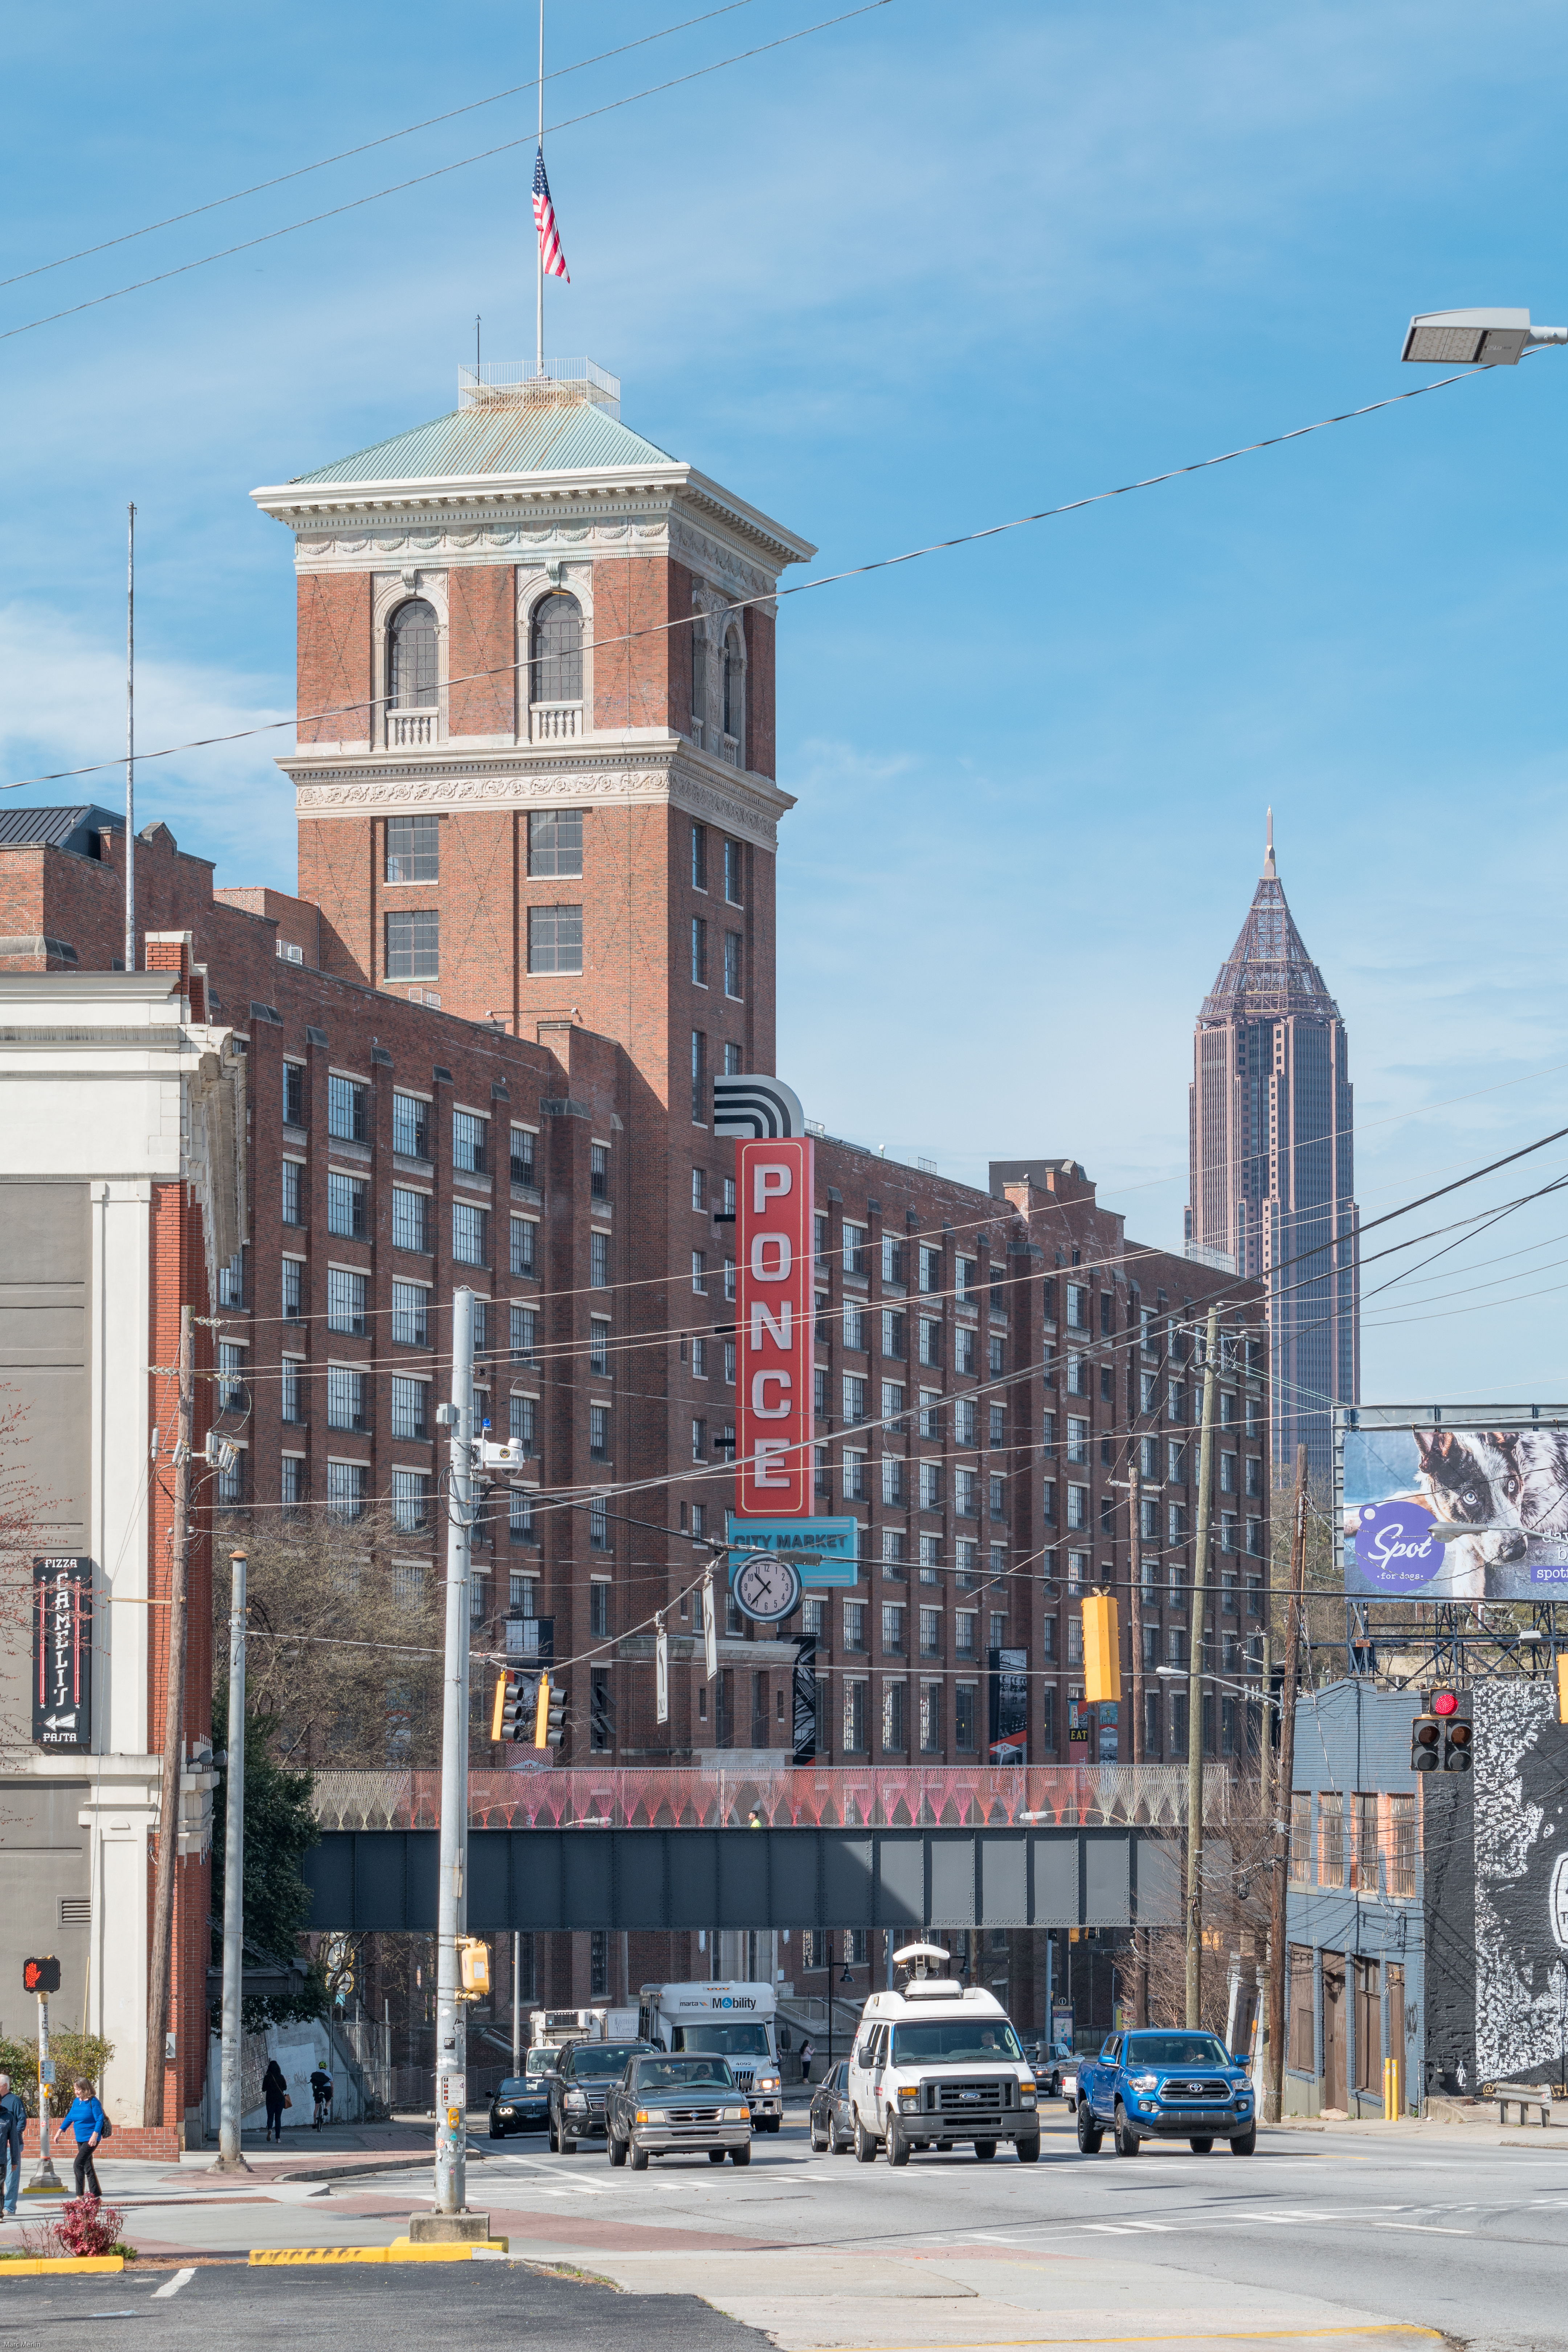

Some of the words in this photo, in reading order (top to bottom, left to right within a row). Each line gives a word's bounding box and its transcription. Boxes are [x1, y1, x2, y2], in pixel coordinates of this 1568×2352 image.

[751, 1164, 793, 1488] PONCE
[734, 1535, 772, 1548] CITY
[776, 1534, 848, 1548] MARKET
[1368, 1523, 1432, 1569] Spot
[45, 1559, 78, 1568] PIZZA
[748, 1573, 754, 1582] 10
[781, 1573, 785, 1581] 2
[1399, 1572, 1420, 1581] dogs
[744, 1583, 748, 1591] 9
[785, 1583, 789, 1591] 3
[747, 1593, 751, 1601] 8
[781, 1593, 785, 1601] 4
[756, 1599, 759, 1608] 7
[774, 1600, 777, 1608] 5
[53, 1572, 71, 1706] CAMELI'S
[43, 1733, 77, 1742] PASTA
[1070, 1730, 1088, 1740] EAT
[712, 1997, 756, 2010] Mobility
